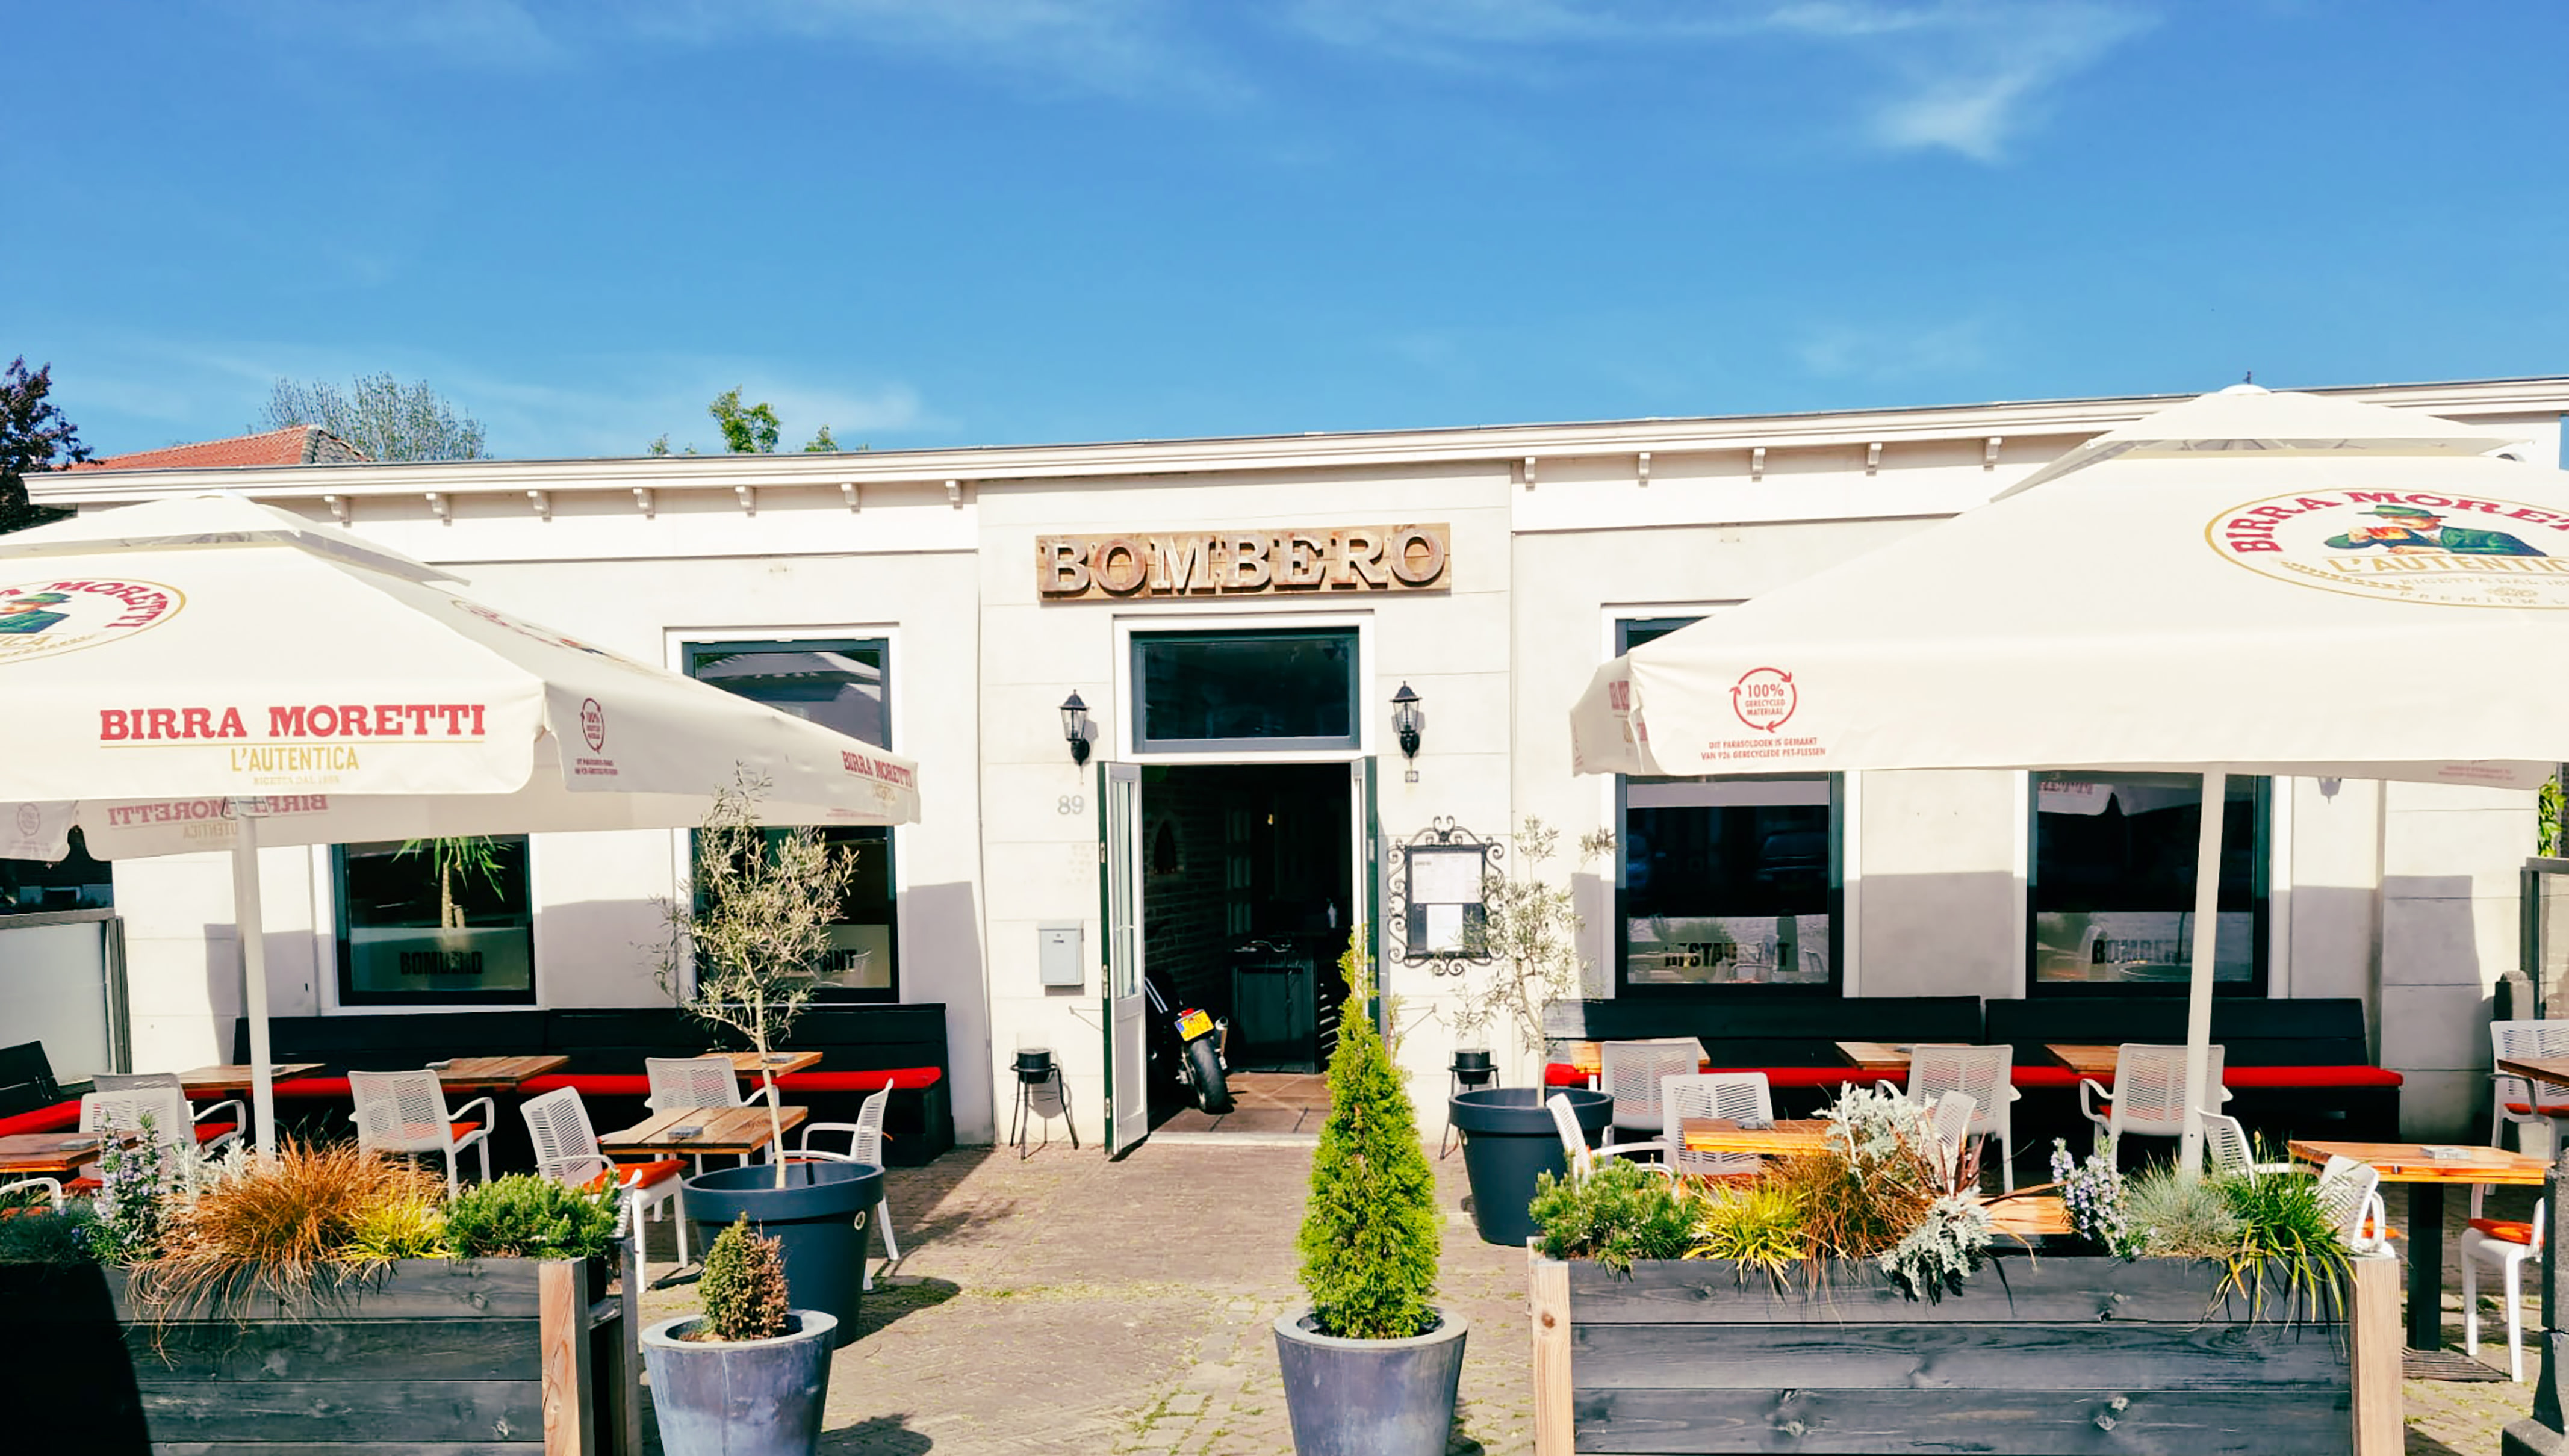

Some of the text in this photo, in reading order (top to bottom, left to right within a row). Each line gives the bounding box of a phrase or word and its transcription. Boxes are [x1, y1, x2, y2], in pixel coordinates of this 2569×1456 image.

[2226, 498, 2343, 552] BIRRA
[1043, 526, 1445, 595] BOMBERO
[39, 581, 168, 628] MORETTI
[1748, 684, 1784, 698] 100%
[1745, 699, 1786, 707] GERECYCLED
[1746, 707, 1784, 716] MATERIAAL
[100, 704, 485, 740] BIRRA MORETTI
[1700, 752, 1716, 760] VAN
[1733, 749, 1780, 758] GERECYCLEDE
[1782, 747, 1827, 757] PET-FLESSEN
[1709, 741, 1721, 750] DIT
[1723, 739, 1772, 749] PARASOLDOEK
[1783, 737, 1818, 746] GEMAAKT
[231, 746, 360, 772] L'AUTENTICA
[842, 751, 913, 788] BIRRA MORETTI
[1057, 795, 1084, 815] 89
